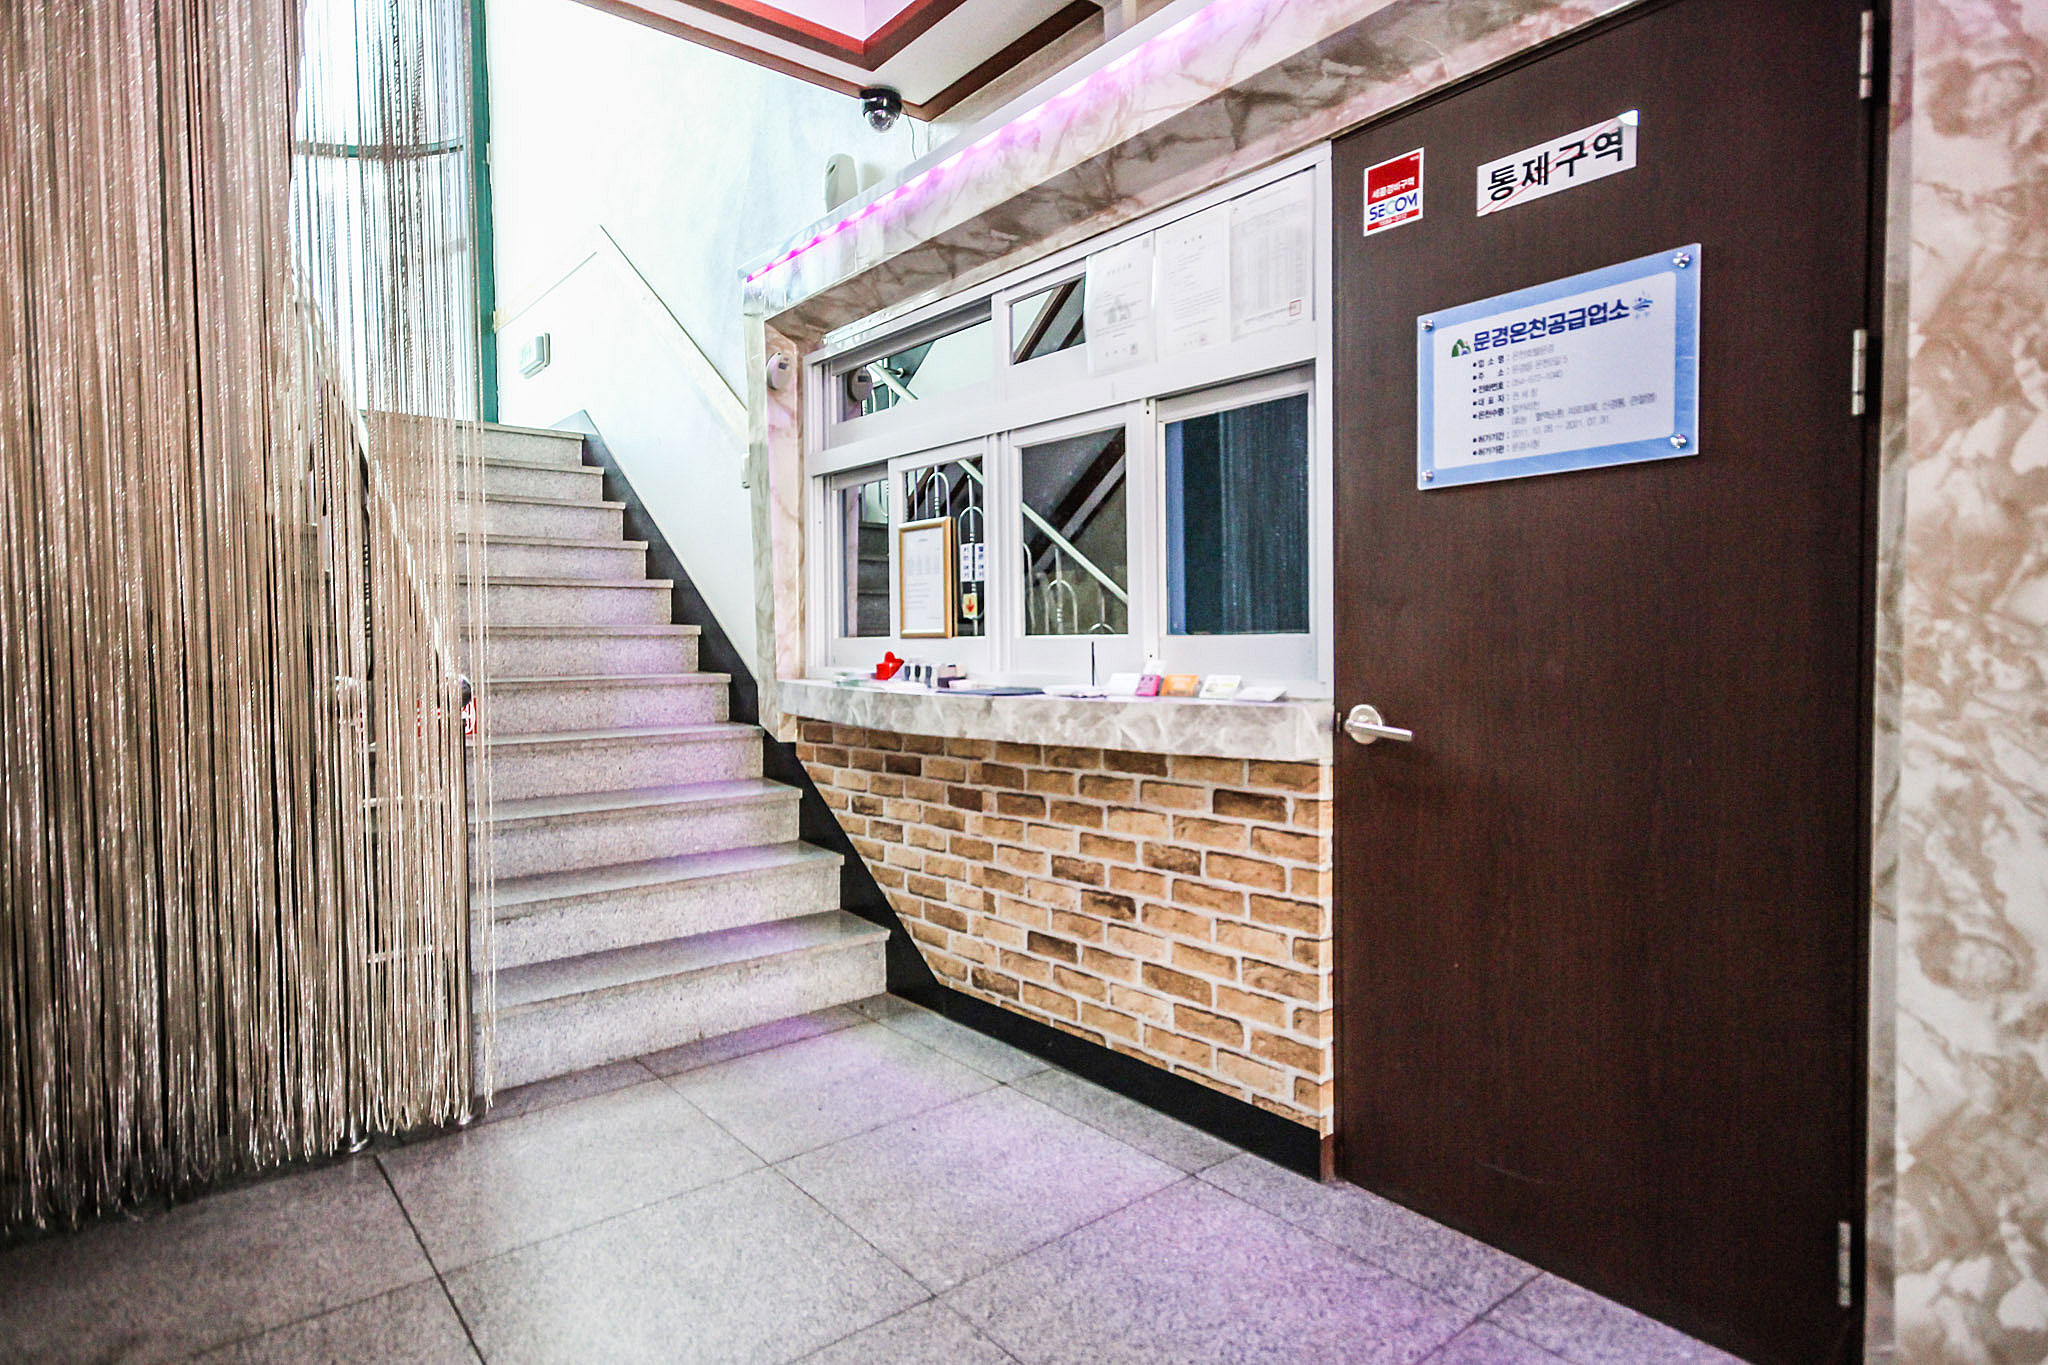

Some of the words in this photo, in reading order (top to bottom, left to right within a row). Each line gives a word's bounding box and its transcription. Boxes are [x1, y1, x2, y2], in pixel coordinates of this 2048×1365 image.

[1487, 126, 1624, 202] 통제구역
[1369, 191, 1418, 221] SECOM
[1473, 298, 1631, 352] 문경온천공급업소
